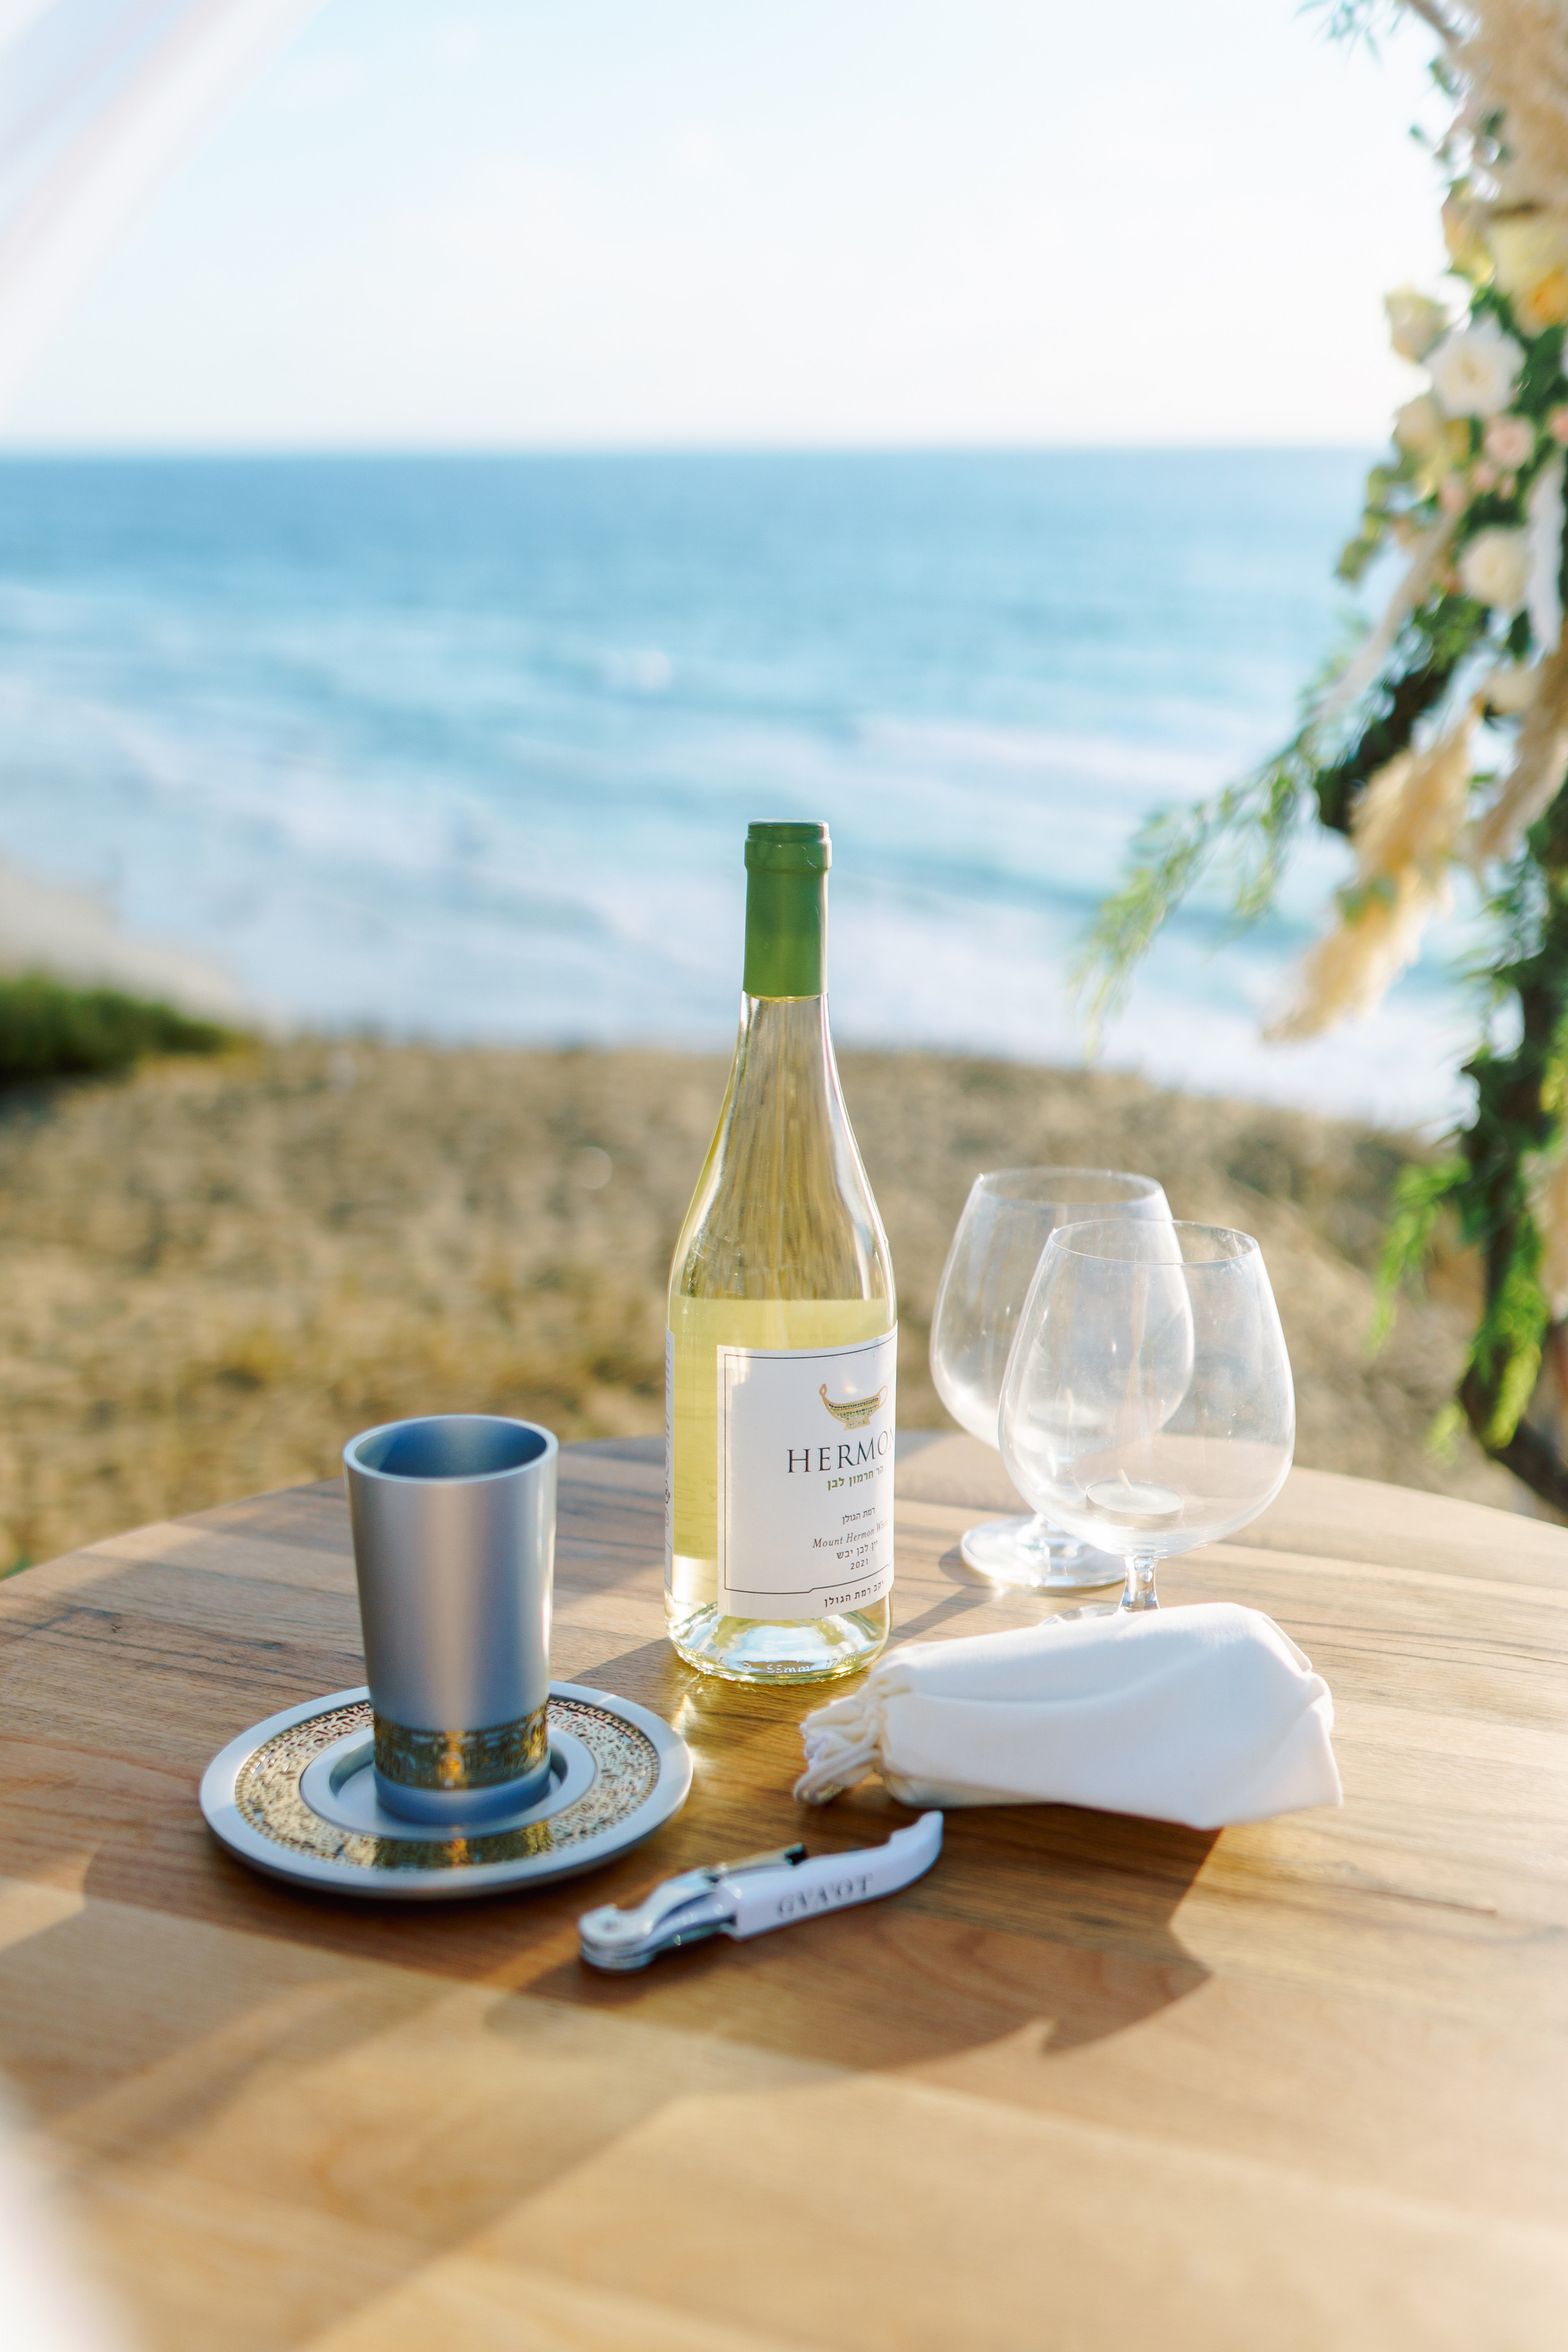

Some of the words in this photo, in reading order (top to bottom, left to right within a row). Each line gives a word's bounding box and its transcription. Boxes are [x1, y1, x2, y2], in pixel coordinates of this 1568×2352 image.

[787, 1426, 894, 1474] HERMON
[876, 1465, 884, 1475] הר
[827, 1477, 845, 1491] לבן
[849, 1470, 874, 1487] חרמון
[862, 1507, 875, 1518] רמת
[842, 1513, 861, 1525] הגולן
[812, 1537, 843, 1548] Mount
[846, 1528, 875, 1544] Hermon
[837, 1550, 854, 1559] יבש
[856, 1544, 869, 1556] לבן
[850, 1558, 869, 1570] 2021
[873, 1580, 884, 1592] יקב
[854, 1588, 871, 1599] רמת
[824, 1594, 851, 1608] הגולן
